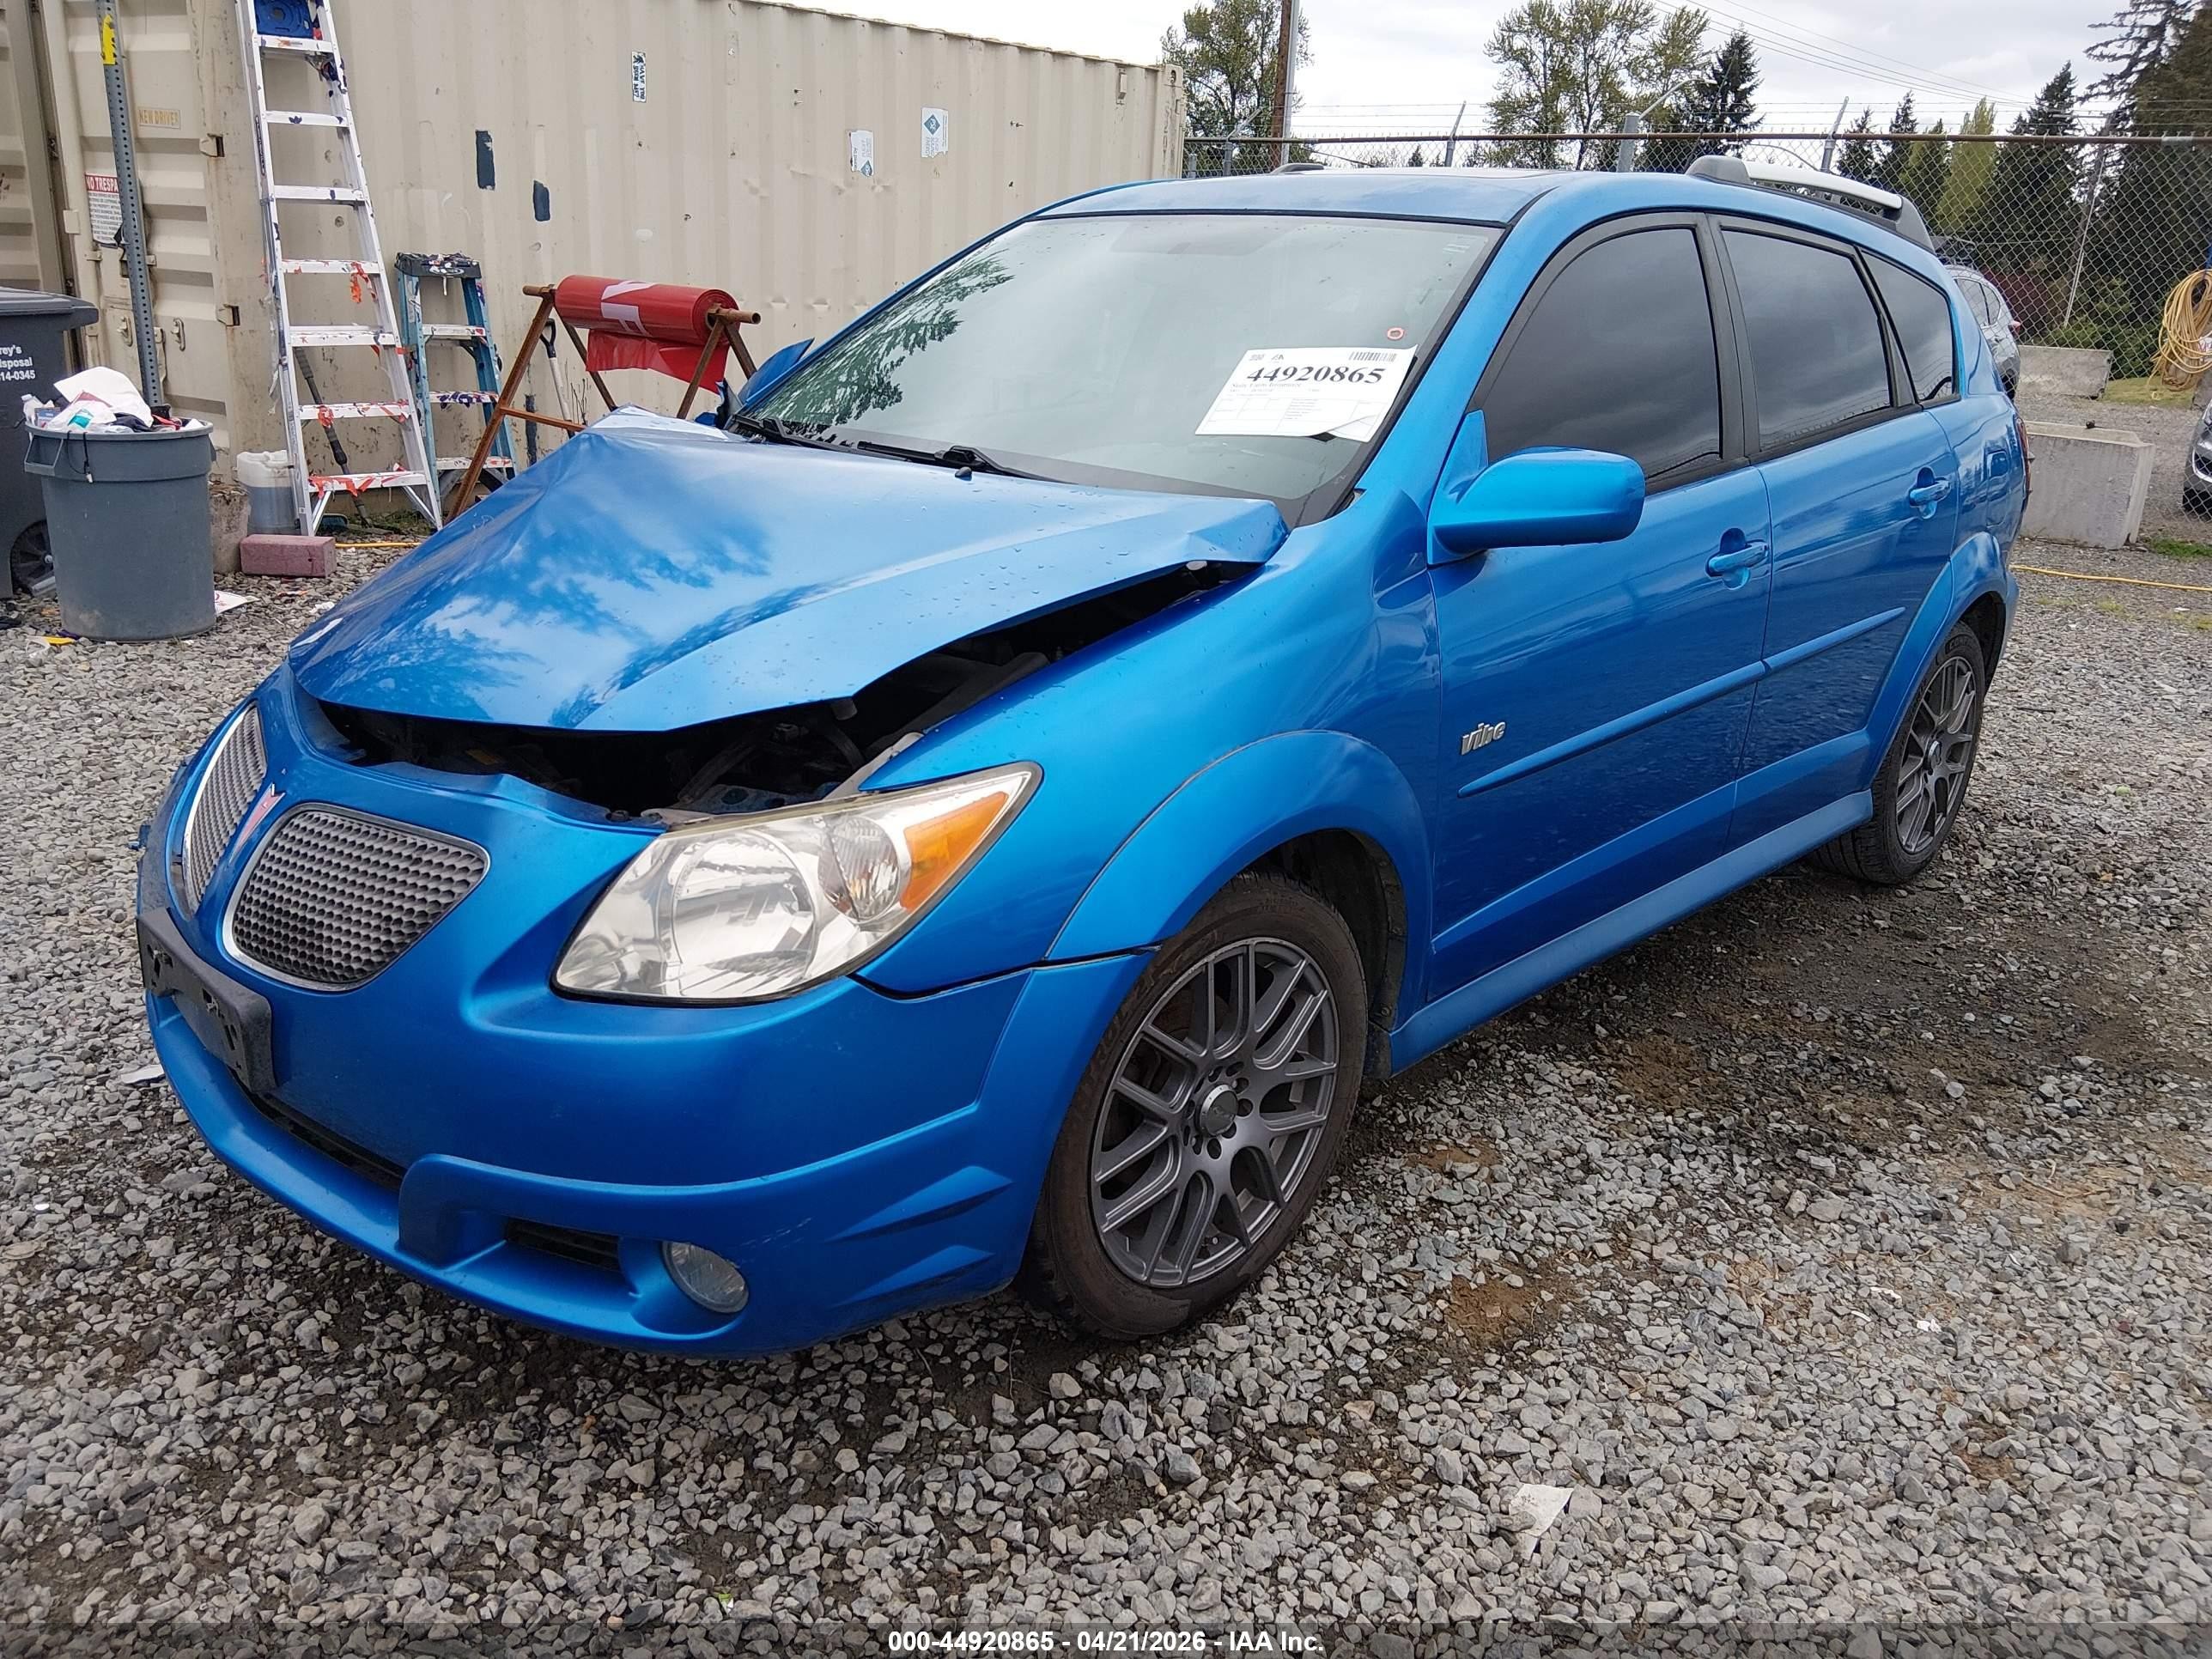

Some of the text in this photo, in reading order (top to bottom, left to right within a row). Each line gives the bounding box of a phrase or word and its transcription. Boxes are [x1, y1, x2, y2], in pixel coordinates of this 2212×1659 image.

[138, 109, 153, 124] NEW
[0, 369, 36, 381] 14-0345
[1247, 367, 1386, 384] 44920865
